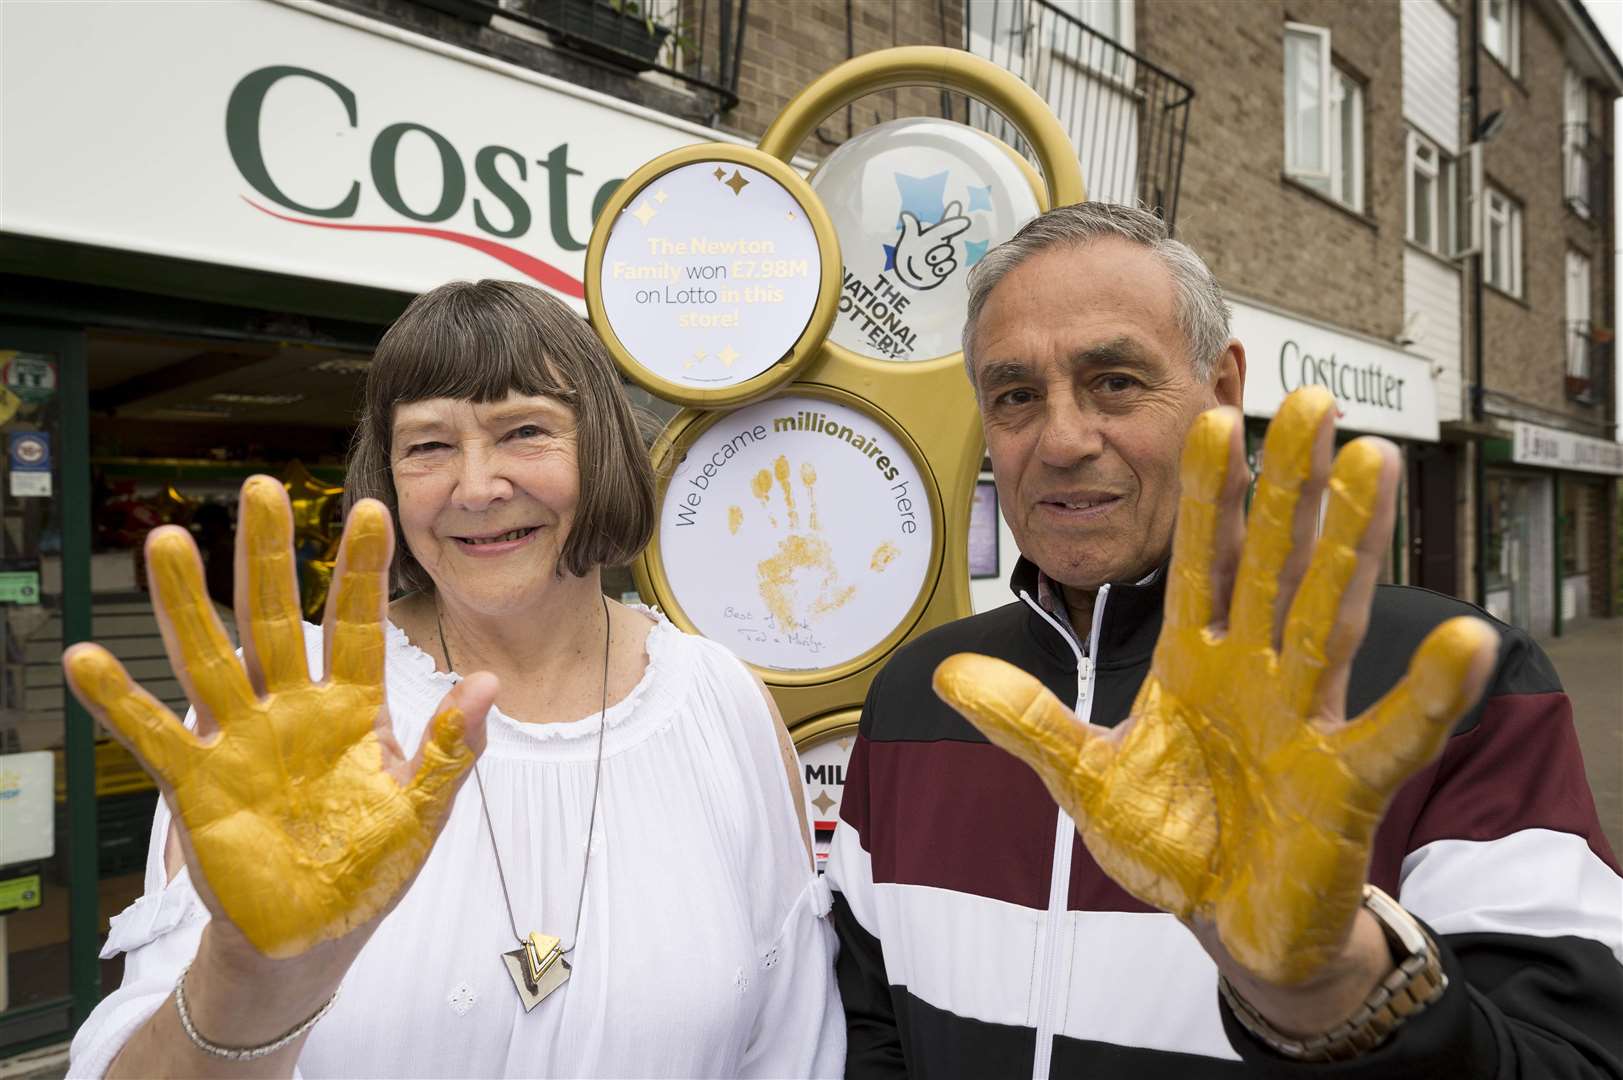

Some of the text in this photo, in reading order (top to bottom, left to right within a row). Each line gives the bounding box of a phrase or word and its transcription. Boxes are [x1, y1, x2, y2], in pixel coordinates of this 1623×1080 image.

[648, 238, 776, 256] The Newton
[613, 261, 682, 283] Family
[686, 264, 727, 280] won
[635, 284, 785, 304] on Lotto in this
[874, 273, 911, 315] THE
[679, 307, 740, 328] store!
[838, 295, 906, 359] OTTERY
[1279, 340, 1404, 412] Costcutter
[675, 411, 918, 535] We became millionaires here
